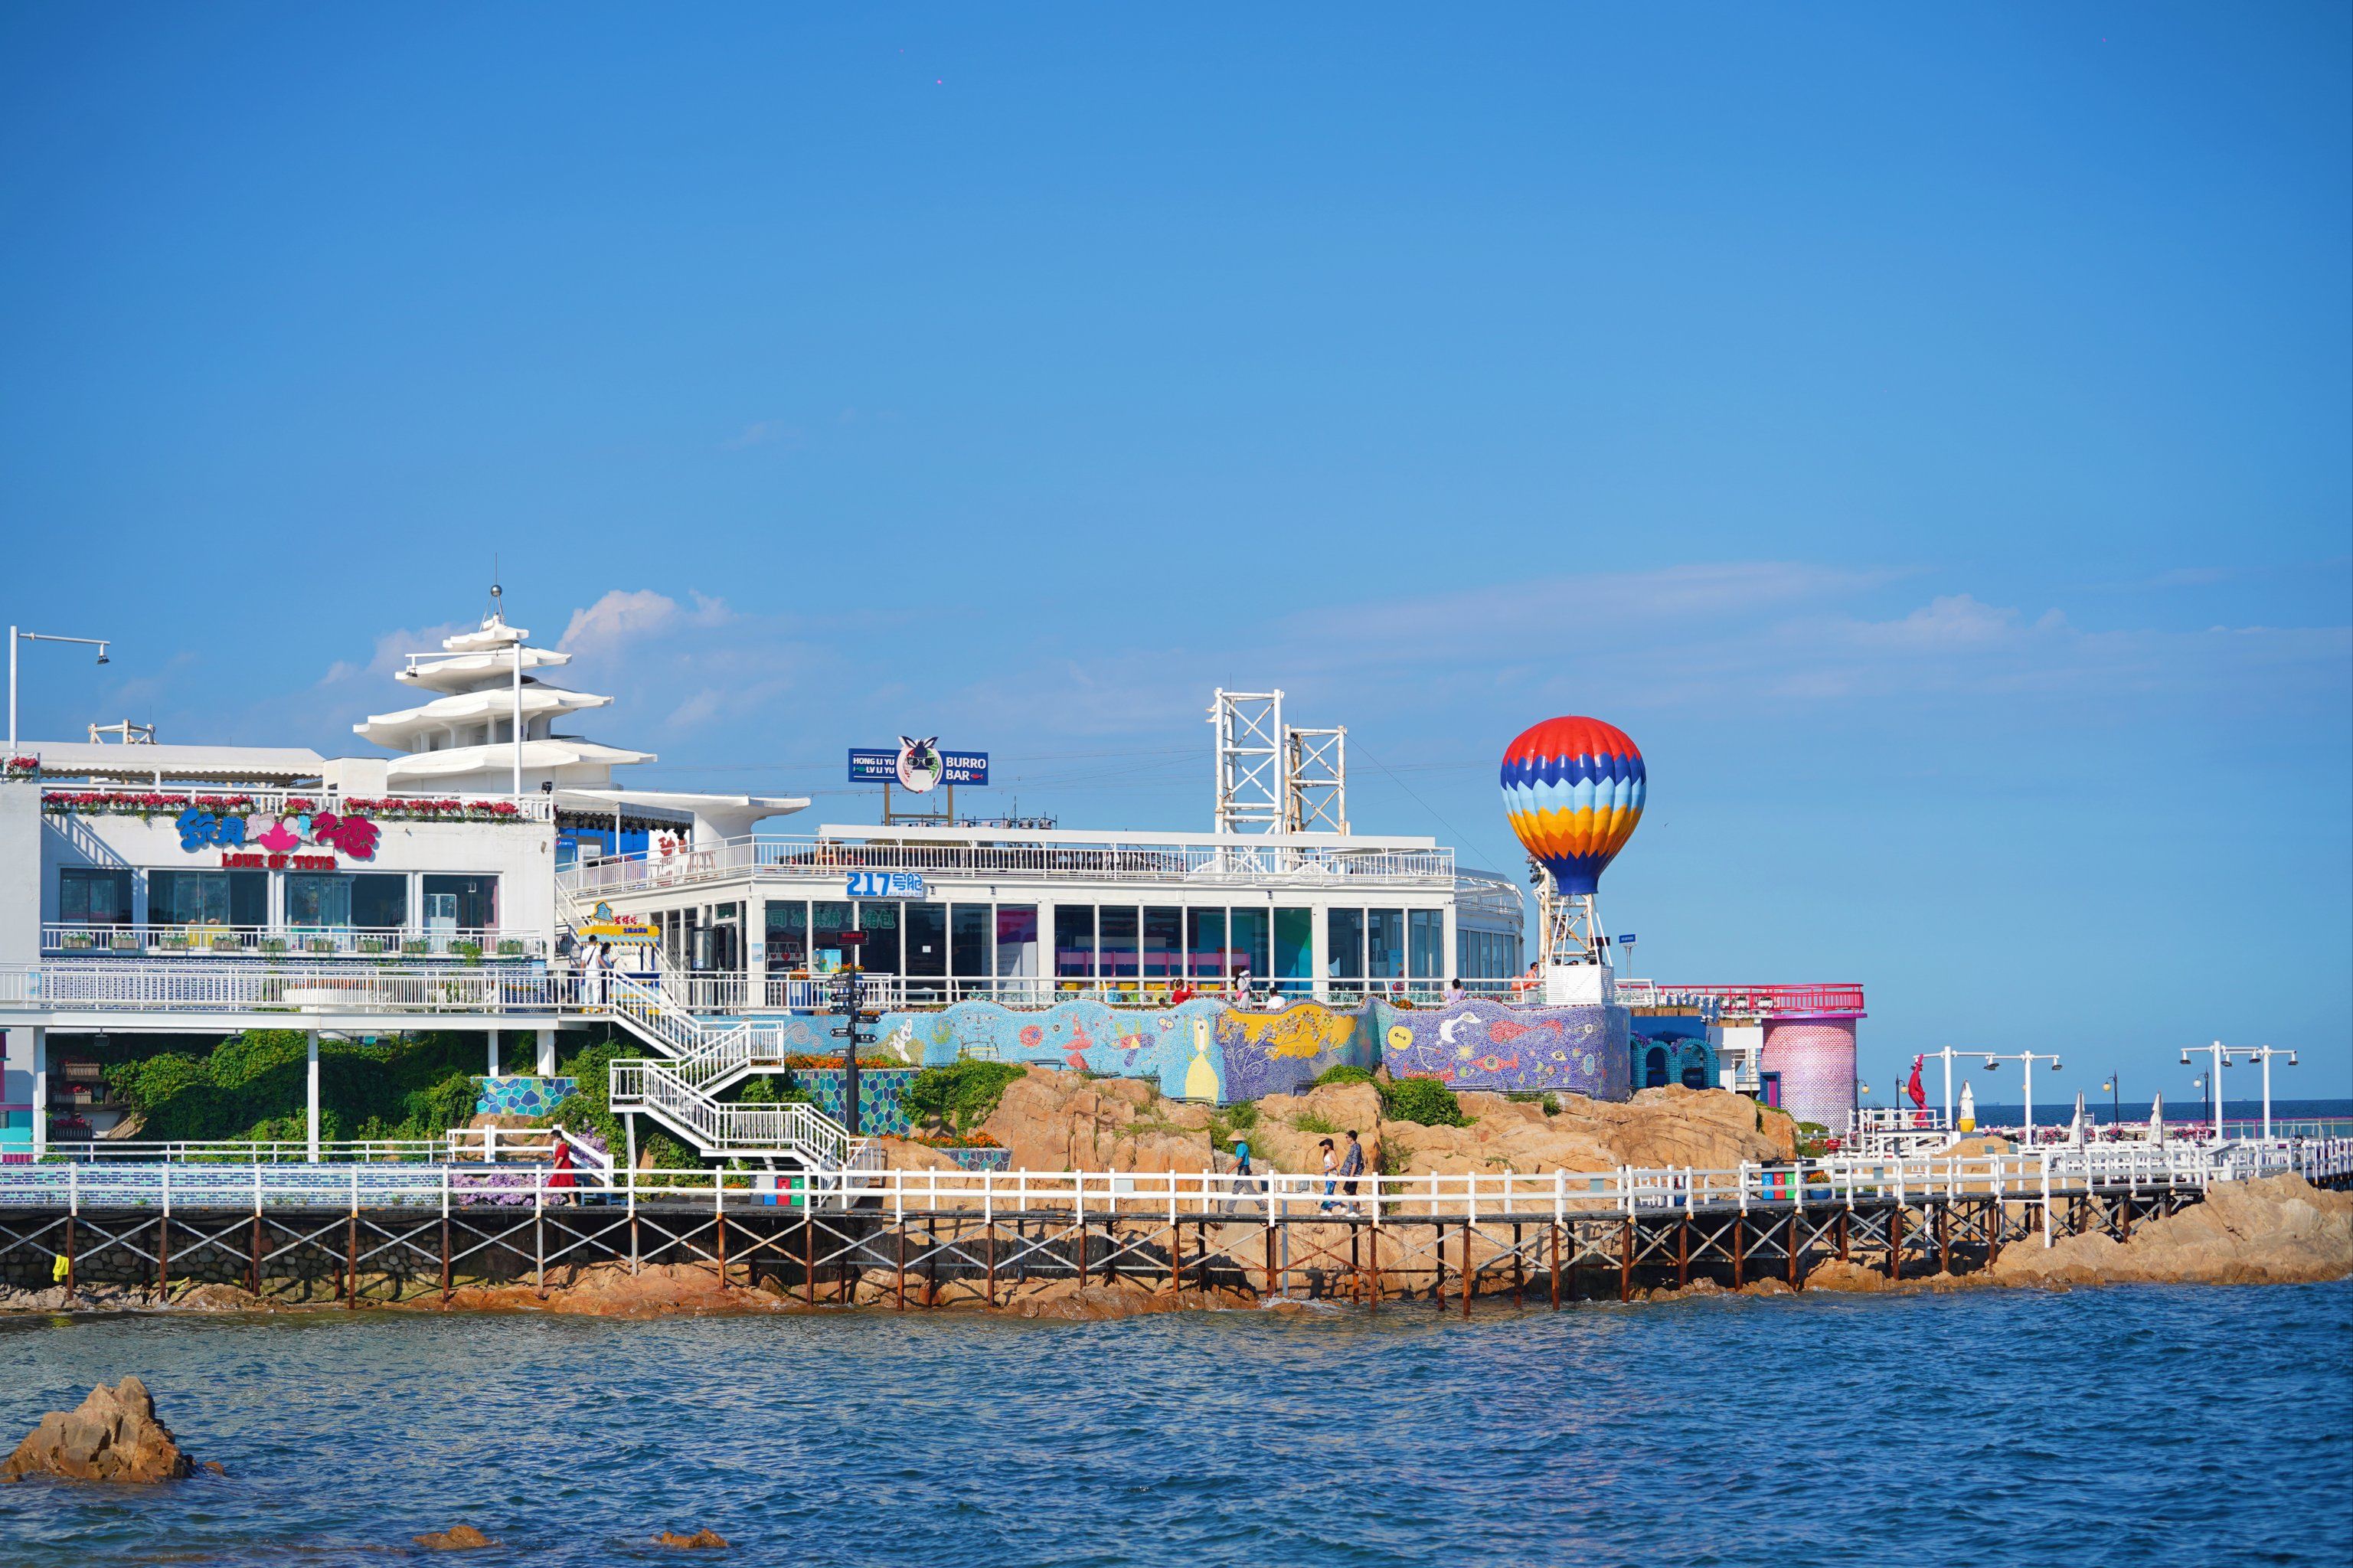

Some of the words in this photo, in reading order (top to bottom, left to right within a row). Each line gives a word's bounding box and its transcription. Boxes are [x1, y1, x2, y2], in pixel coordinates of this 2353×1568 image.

[946, 756, 986, 769] BURRO
[946, 769, 969, 781] BAR
[175, 808, 245, 849] 玩具
[312, 811, 379, 858] 之恋
[222, 853, 264, 869] LOVE
[268, 854, 289, 870] OF
[292, 854, 336, 871] TOYS
